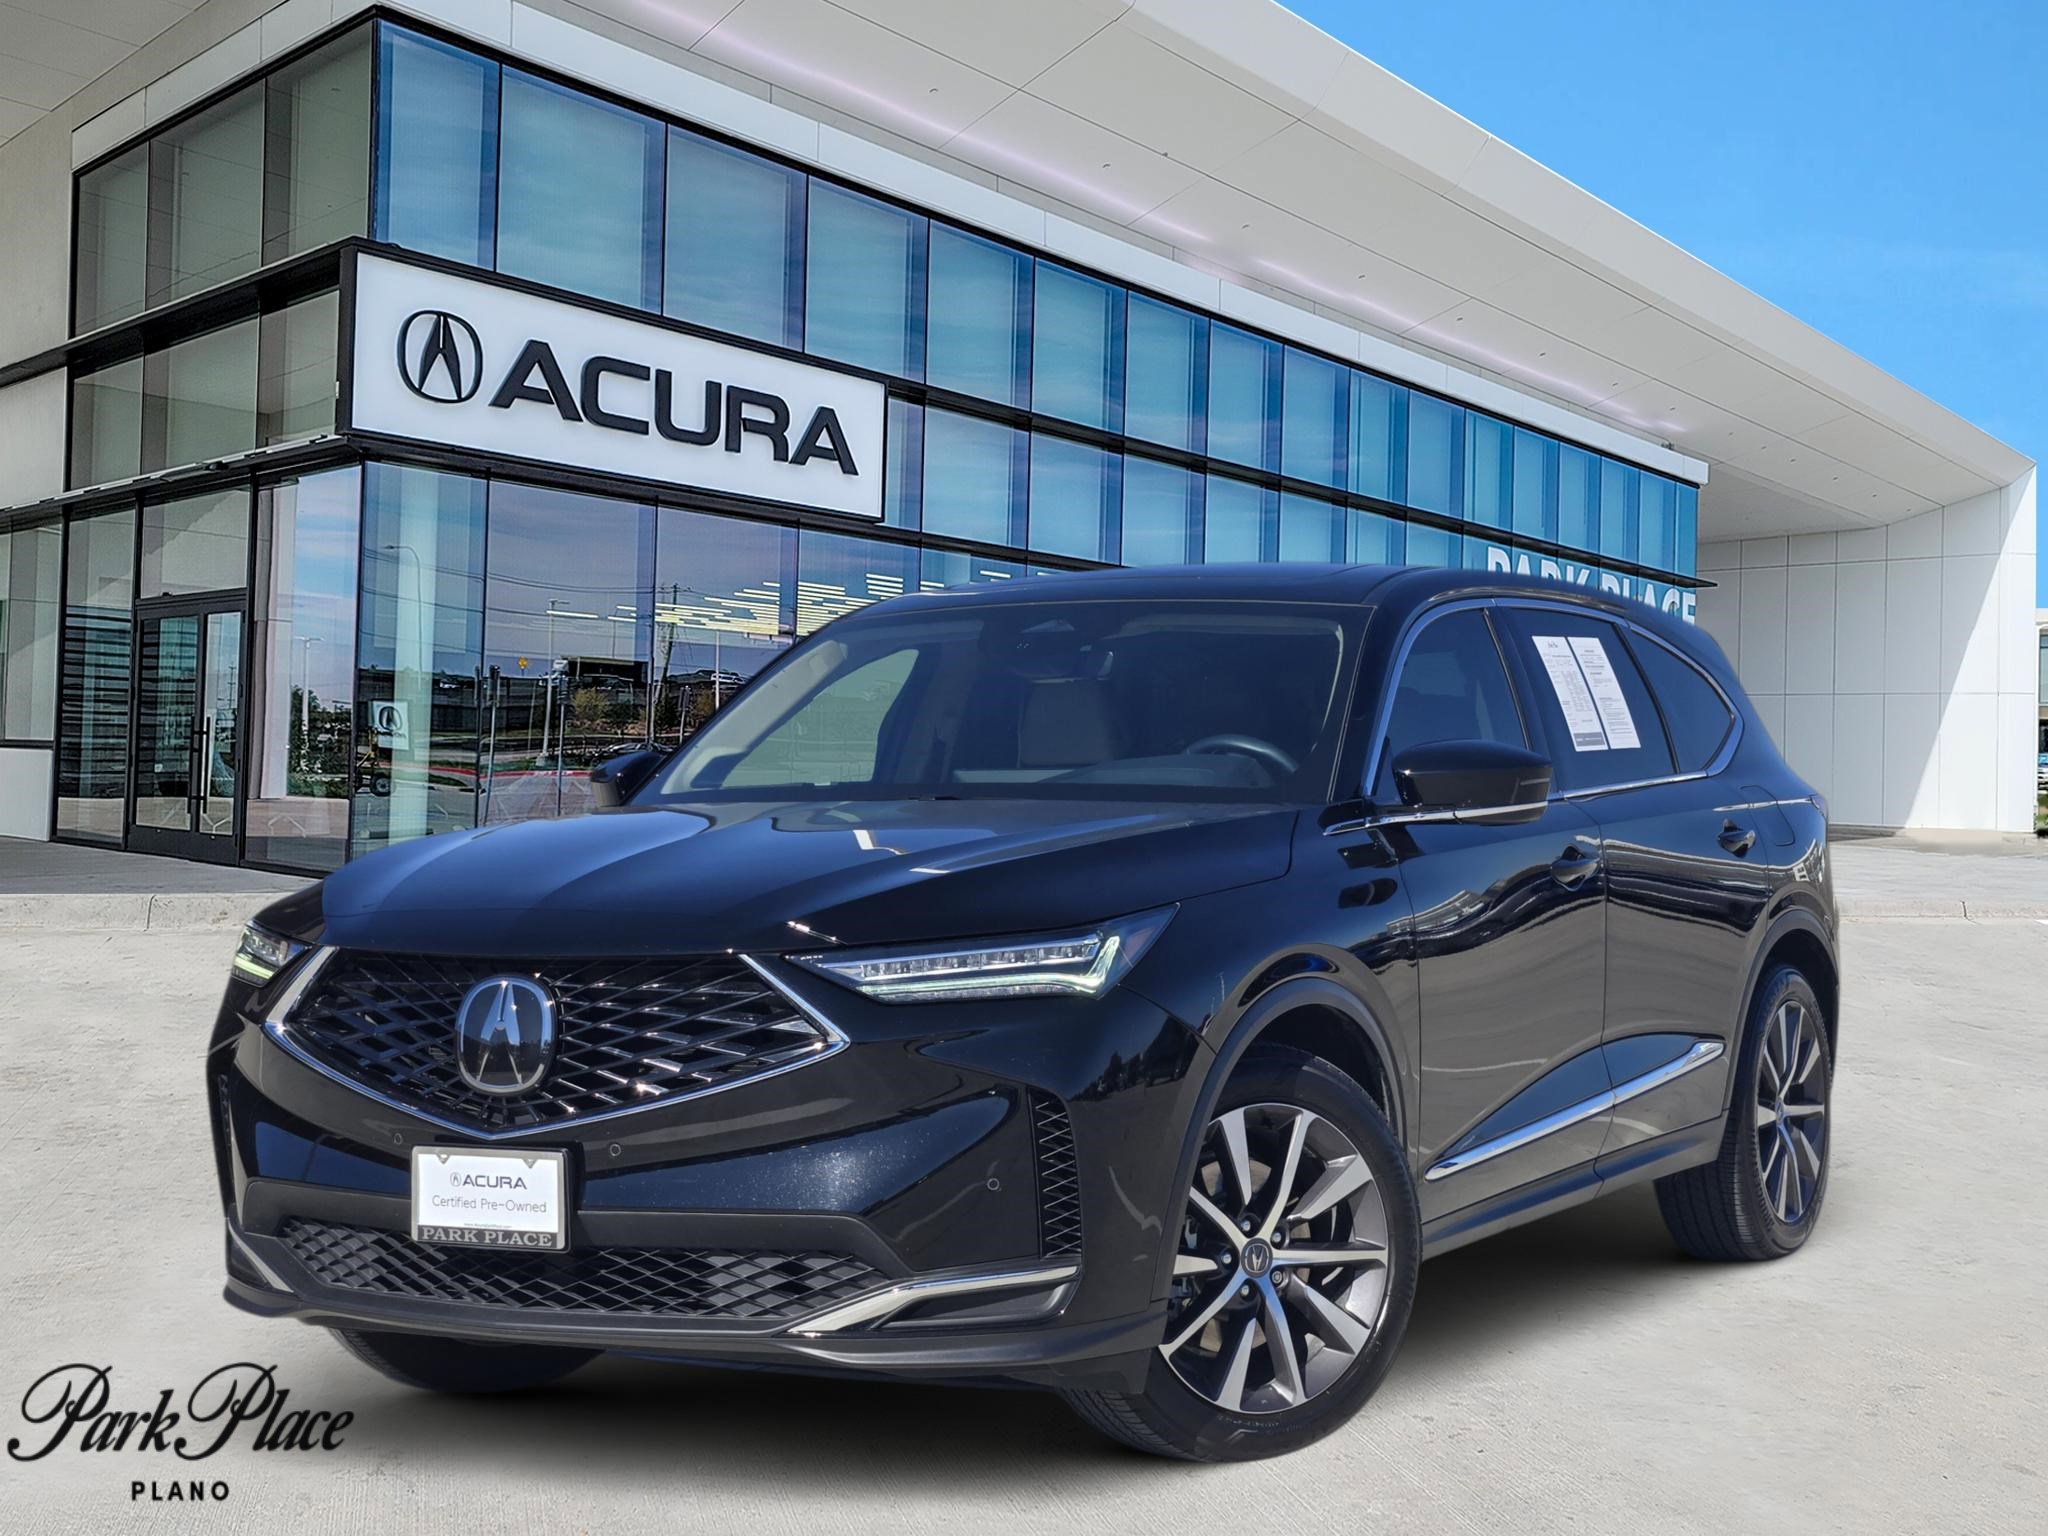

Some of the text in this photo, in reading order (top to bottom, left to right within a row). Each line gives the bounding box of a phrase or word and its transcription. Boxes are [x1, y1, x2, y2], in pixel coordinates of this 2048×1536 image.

[488, 339, 860, 476] ACURA
[463, 1175, 527, 1189] ACURA
[433, 1196, 546, 1213] Certified Pre-Owned
[423, 1227, 552, 1246] PARK PLACE
